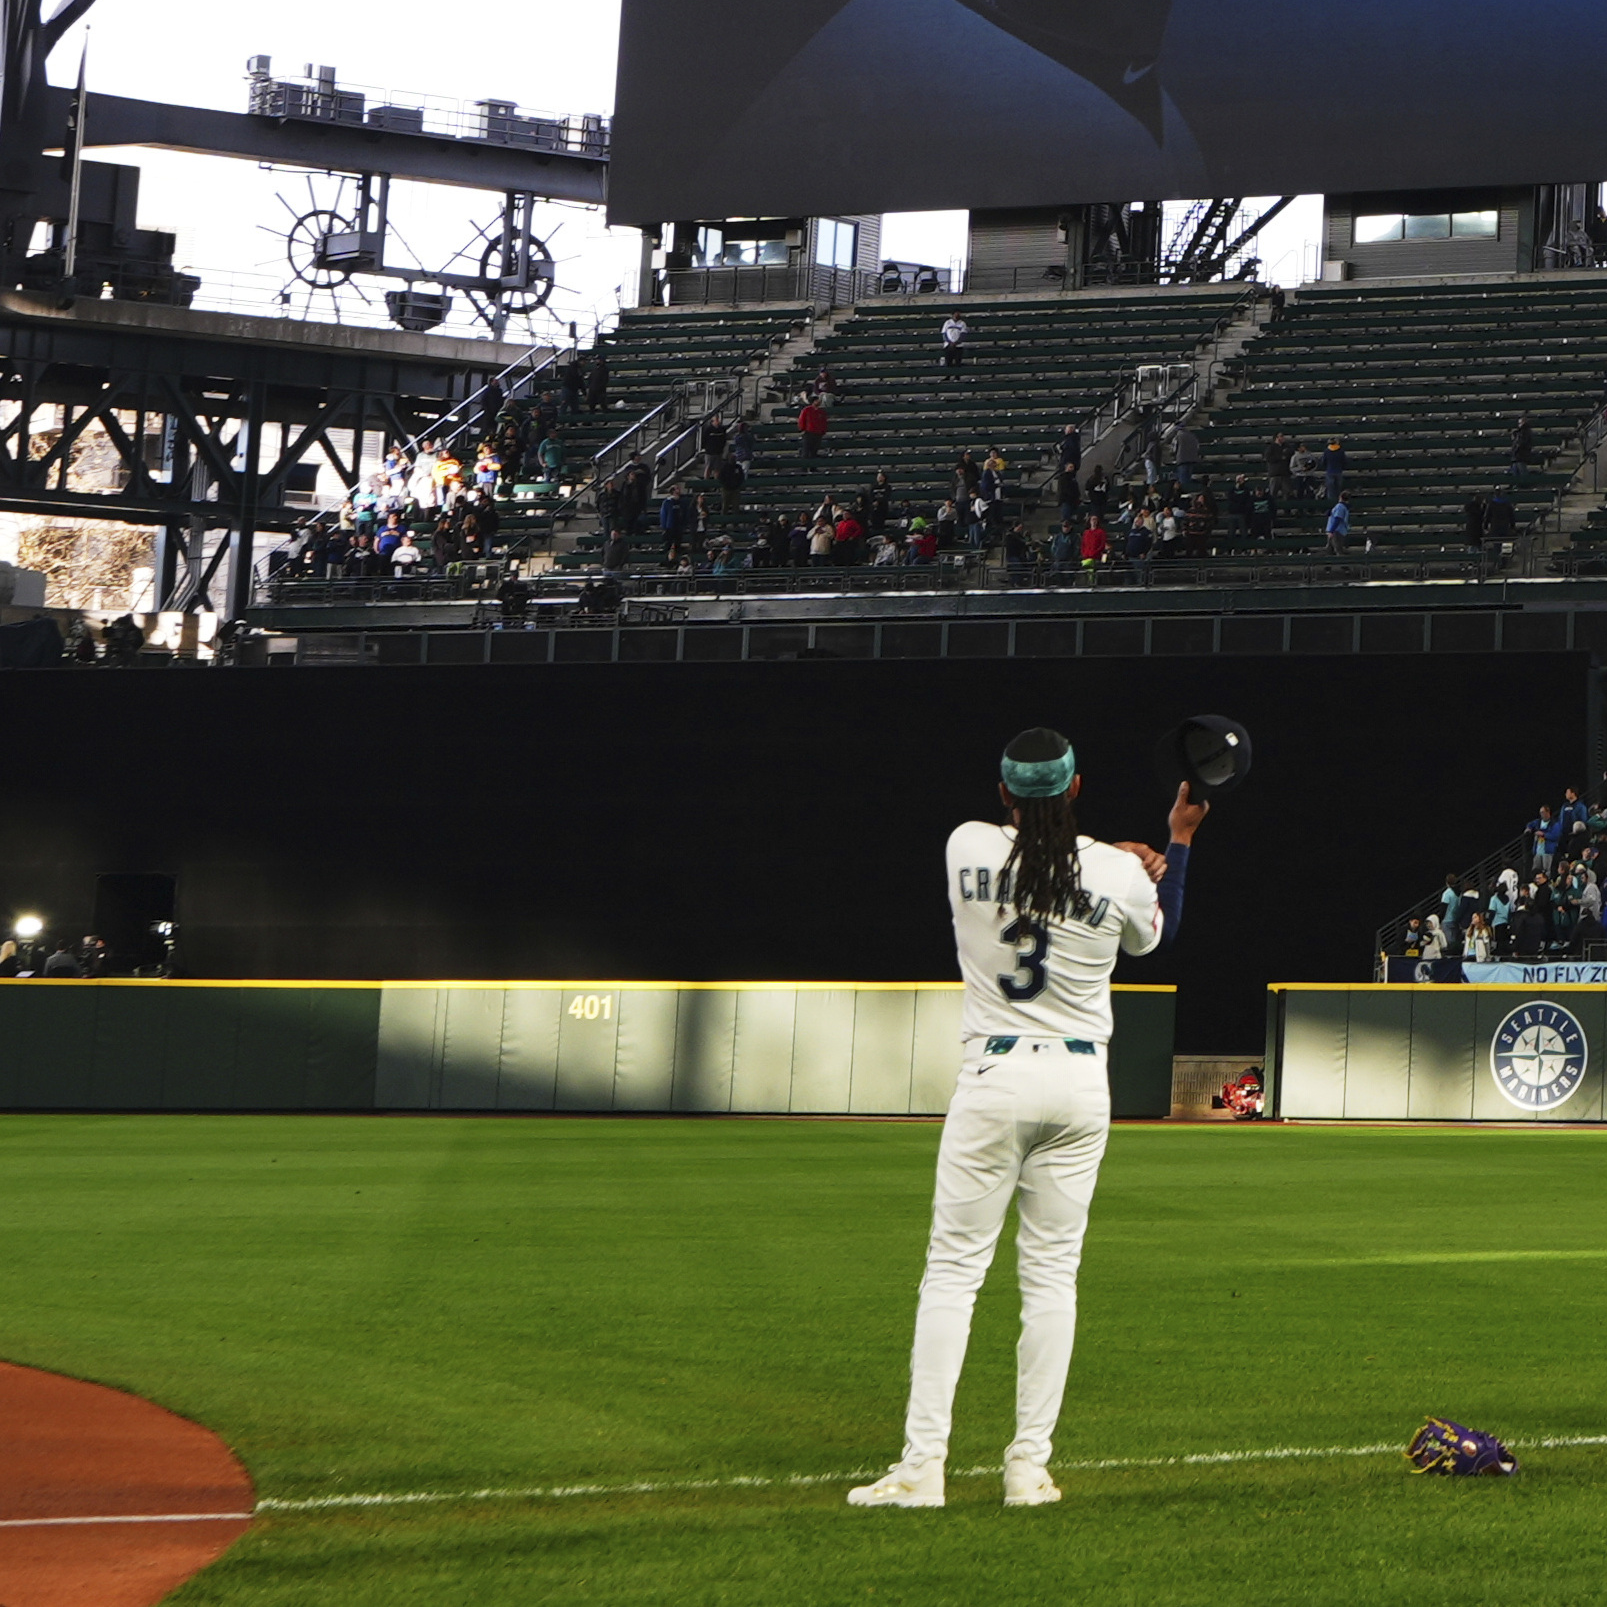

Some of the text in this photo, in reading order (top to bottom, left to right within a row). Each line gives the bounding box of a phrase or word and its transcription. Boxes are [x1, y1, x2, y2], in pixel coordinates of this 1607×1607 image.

[997, 916, 1049, 1003] 3
[1522, 967, 1548, 984] NO
[1554, 967, 1586, 984] FLY
[568, 994, 612, 1020] 401
[1501, 1008, 1579, 1044] SEATTLE
[1499, 1064, 1579, 1103] MARINERS
